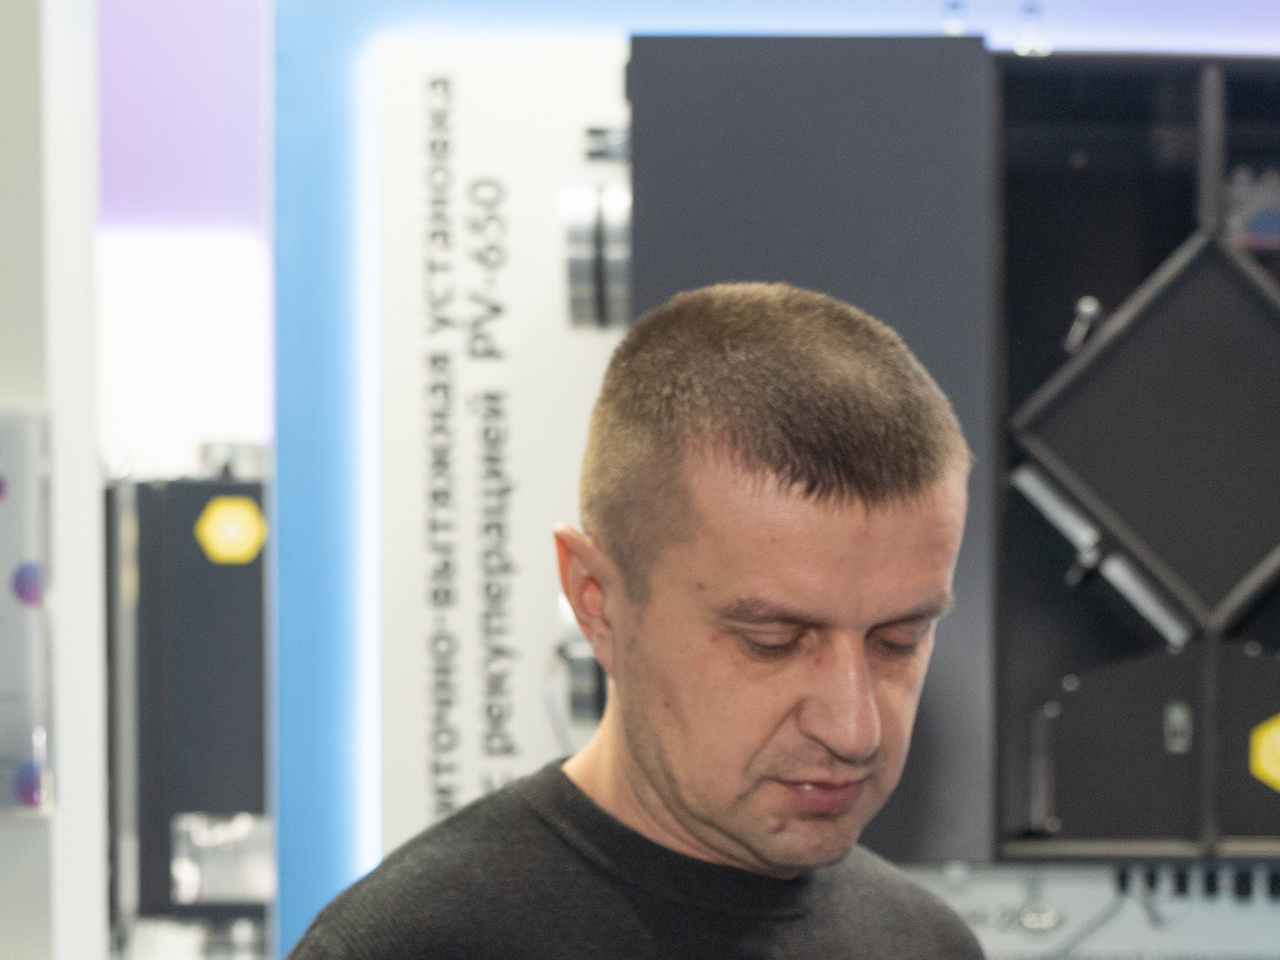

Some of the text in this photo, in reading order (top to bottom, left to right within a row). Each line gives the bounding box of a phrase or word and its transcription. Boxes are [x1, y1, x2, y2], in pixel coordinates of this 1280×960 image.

[428, 76, 459, 336] установка
[466, 176, 506, 360] PV-650
[470, 391, 517, 757] рекуперацией
